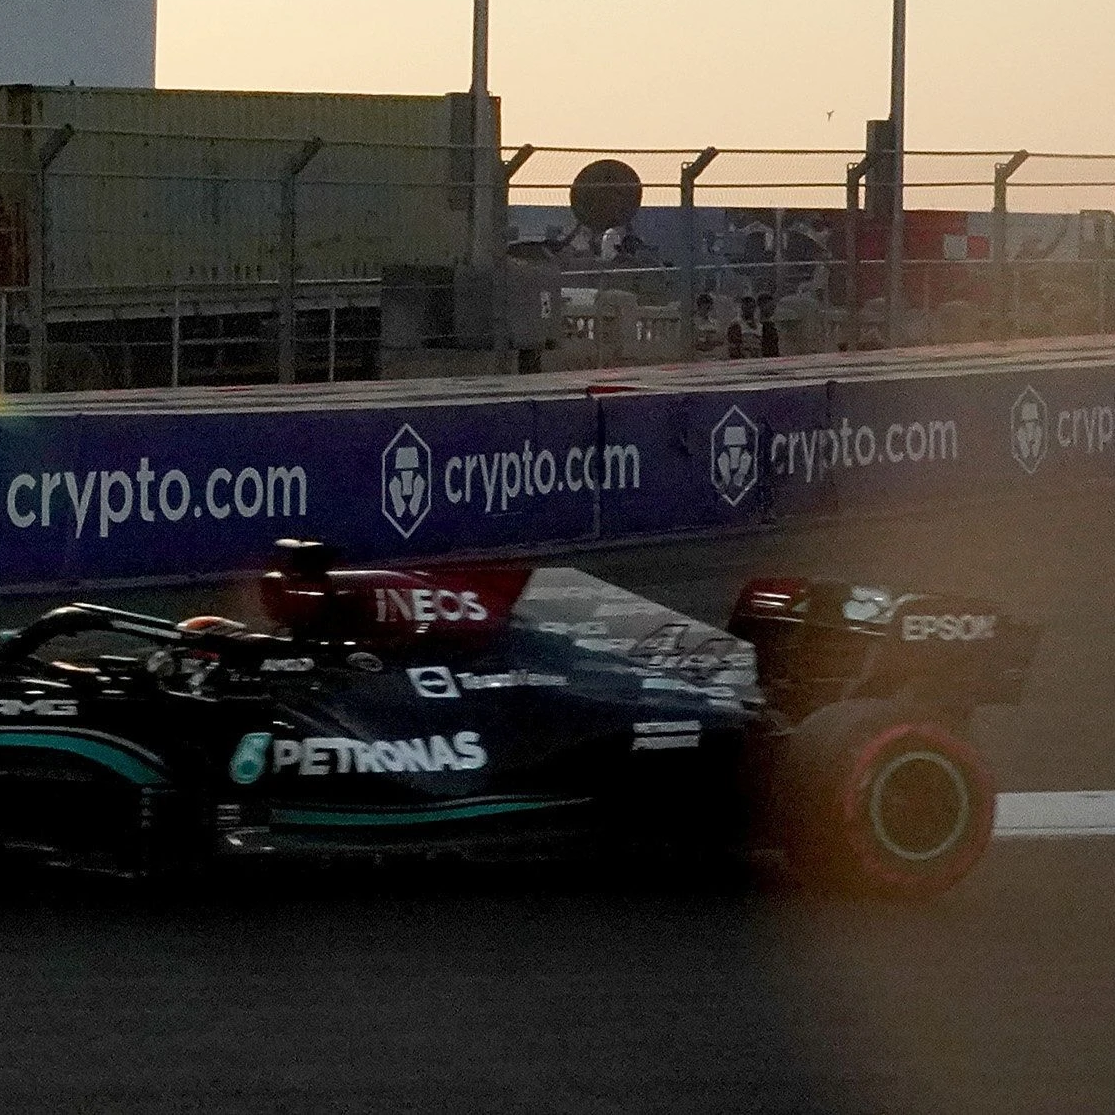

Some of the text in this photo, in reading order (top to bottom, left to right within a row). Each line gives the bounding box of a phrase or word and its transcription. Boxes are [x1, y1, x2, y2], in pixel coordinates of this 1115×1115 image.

[7, 457, 307, 539] crypto.com
[375, 588, 488, 623] INEOS
[272, 730, 488, 776] PETRONAS
